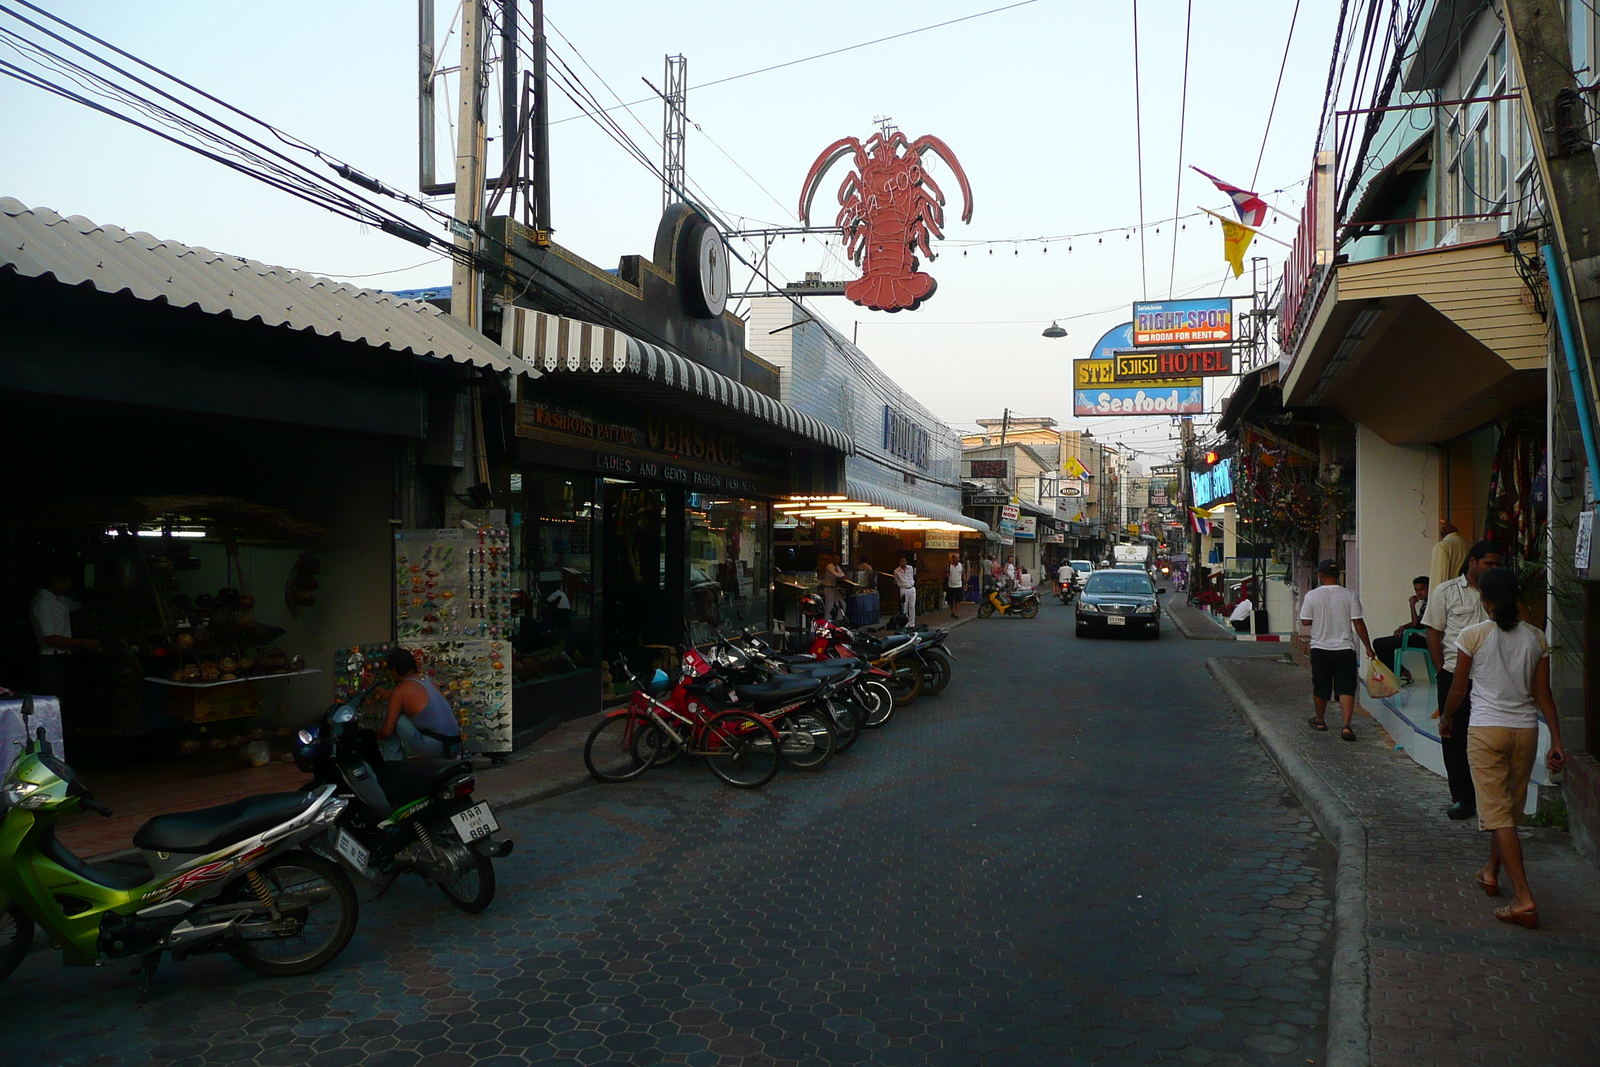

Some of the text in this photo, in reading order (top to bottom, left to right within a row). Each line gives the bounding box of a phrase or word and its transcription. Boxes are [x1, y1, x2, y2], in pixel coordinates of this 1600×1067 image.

[1138, 308, 1227, 331] RIGHT SPOT
[1150, 331, 1212, 341] ROOM FOR RENT
[1160, 351, 1229, 373] HOTEL
[1097, 389, 1178, 412] Seafood
[534, 408, 593, 437] FASHIONS
[645, 410, 741, 467] VERSACE
[596, 454, 631, 473] LADIES
[639, 461, 657, 477] AND
[664, 466, 688, 482] GENTS
[470, 824, 491, 839] 889
[48, 879, 81, 891] HONDA
